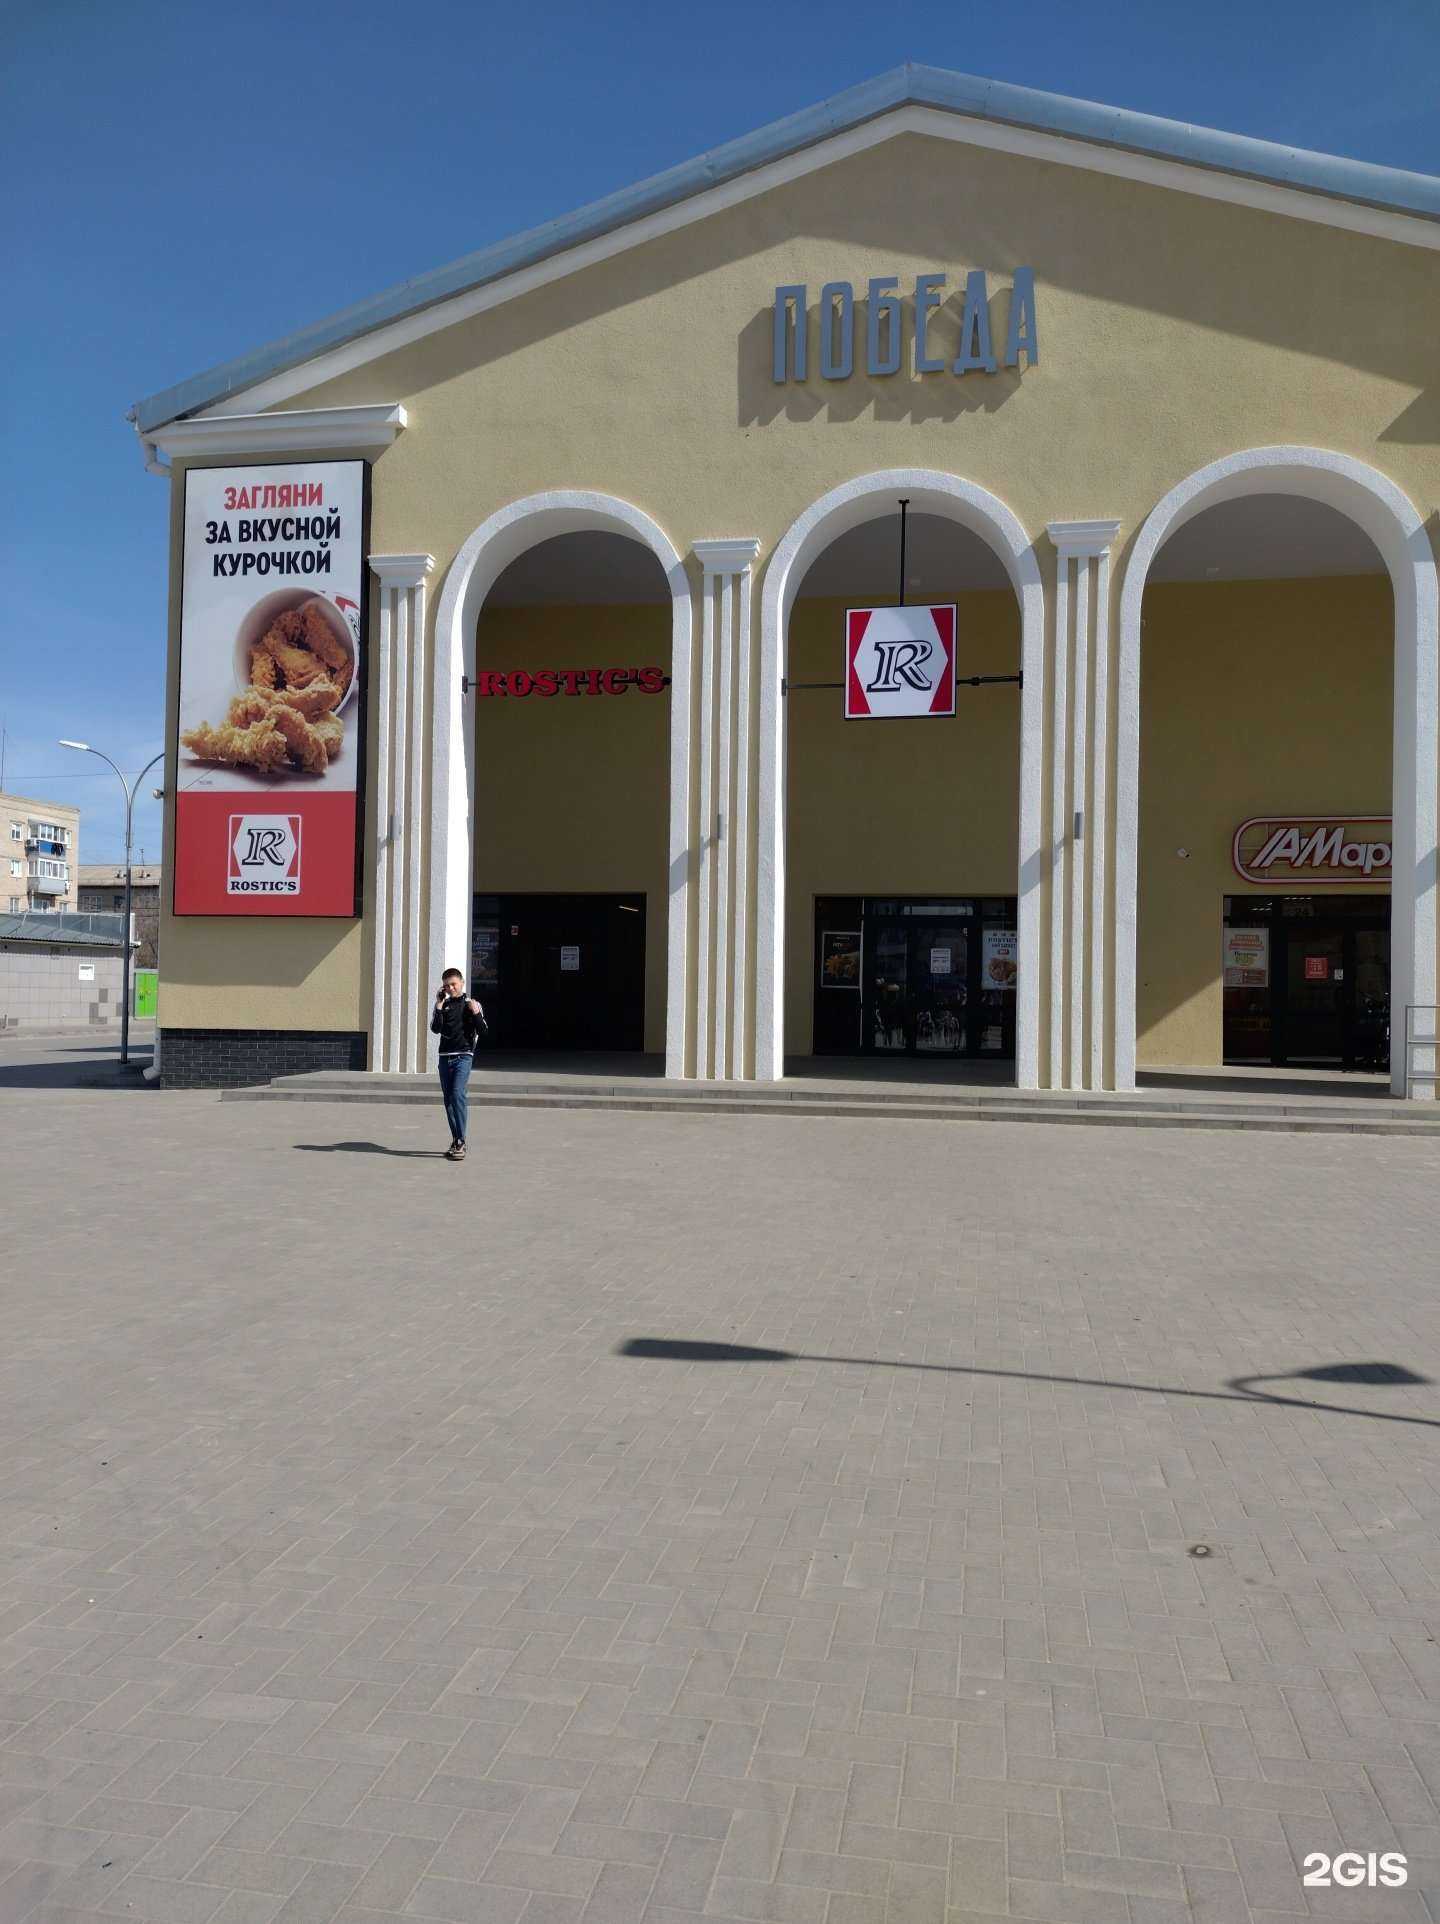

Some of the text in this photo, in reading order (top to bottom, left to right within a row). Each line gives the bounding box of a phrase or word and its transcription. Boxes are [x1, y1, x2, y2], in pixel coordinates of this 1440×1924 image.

[773, 265, 1039, 384] ПОБЕДА
[224, 483, 323, 511] ЗАГЛЯНИ
[205, 507, 341, 544] ЗА ВКУСНОЙ
[213, 541, 331, 576] КУРОЧКОЙ
[479, 667, 665, 697] ROSTIC'S
[1249, 827, 1392, 874] АМар
[230, 881, 297, 891] ROSTIC'S
